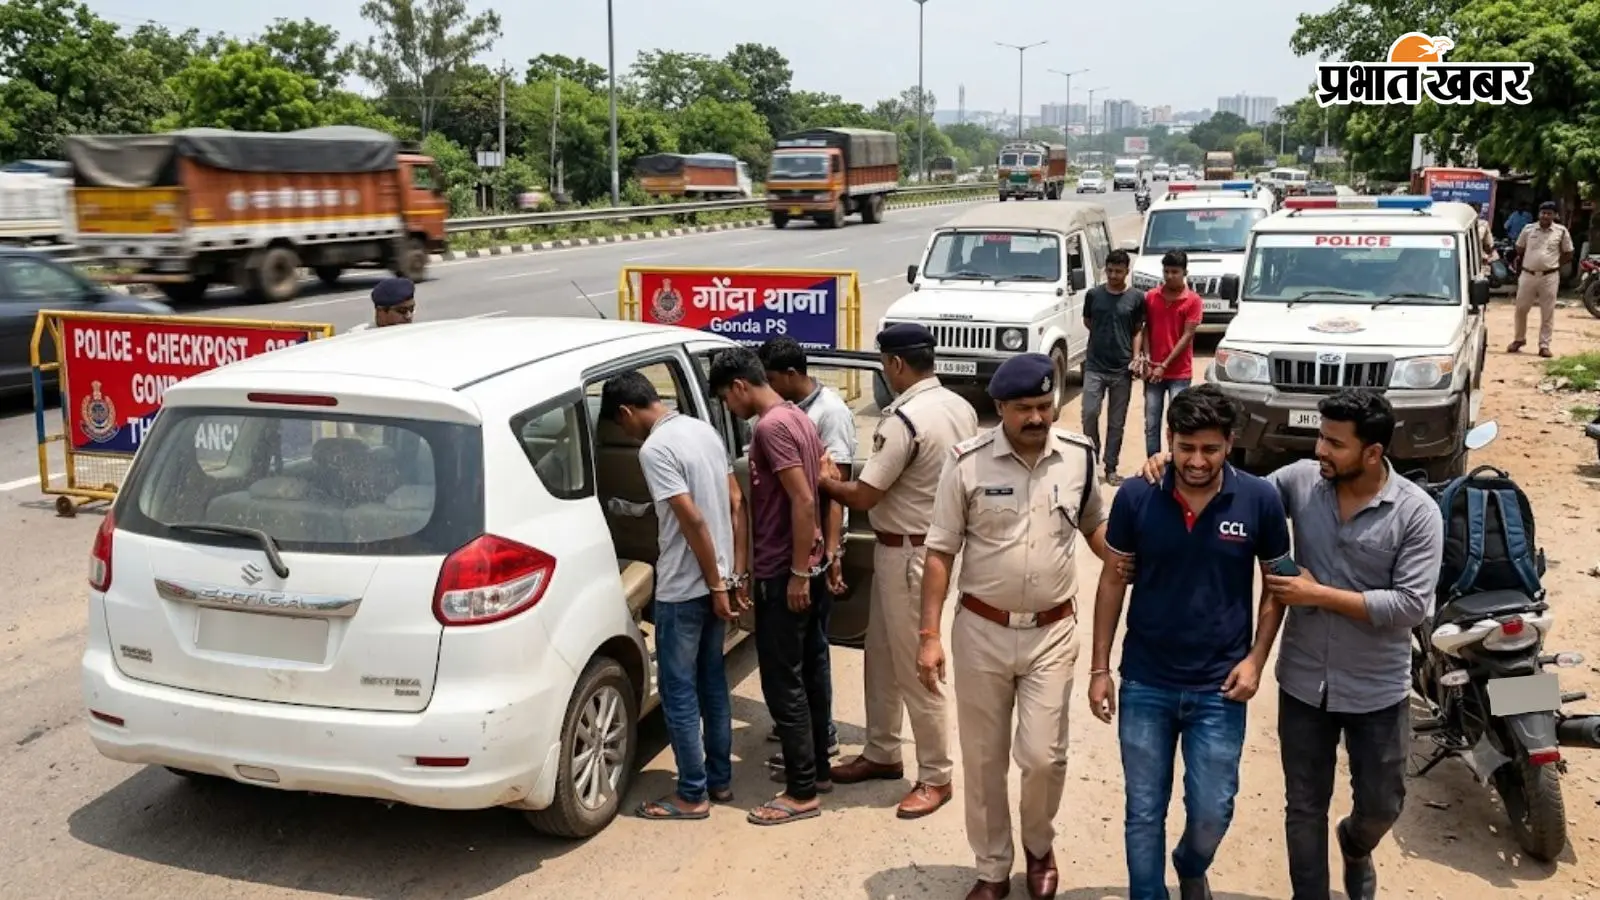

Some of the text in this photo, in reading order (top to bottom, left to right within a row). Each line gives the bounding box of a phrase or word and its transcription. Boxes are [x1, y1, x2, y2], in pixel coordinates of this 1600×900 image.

[1315, 235, 1392, 247] POLICE
[763, 288, 828, 314] थाना
[710, 318, 787, 334] Gonda PS
[74, 328, 133, 362] POLICE
[145, 331, 249, 367] CHECKPOST
[131, 373, 191, 404] GON
[1219, 521, 1248, 537] CCL
